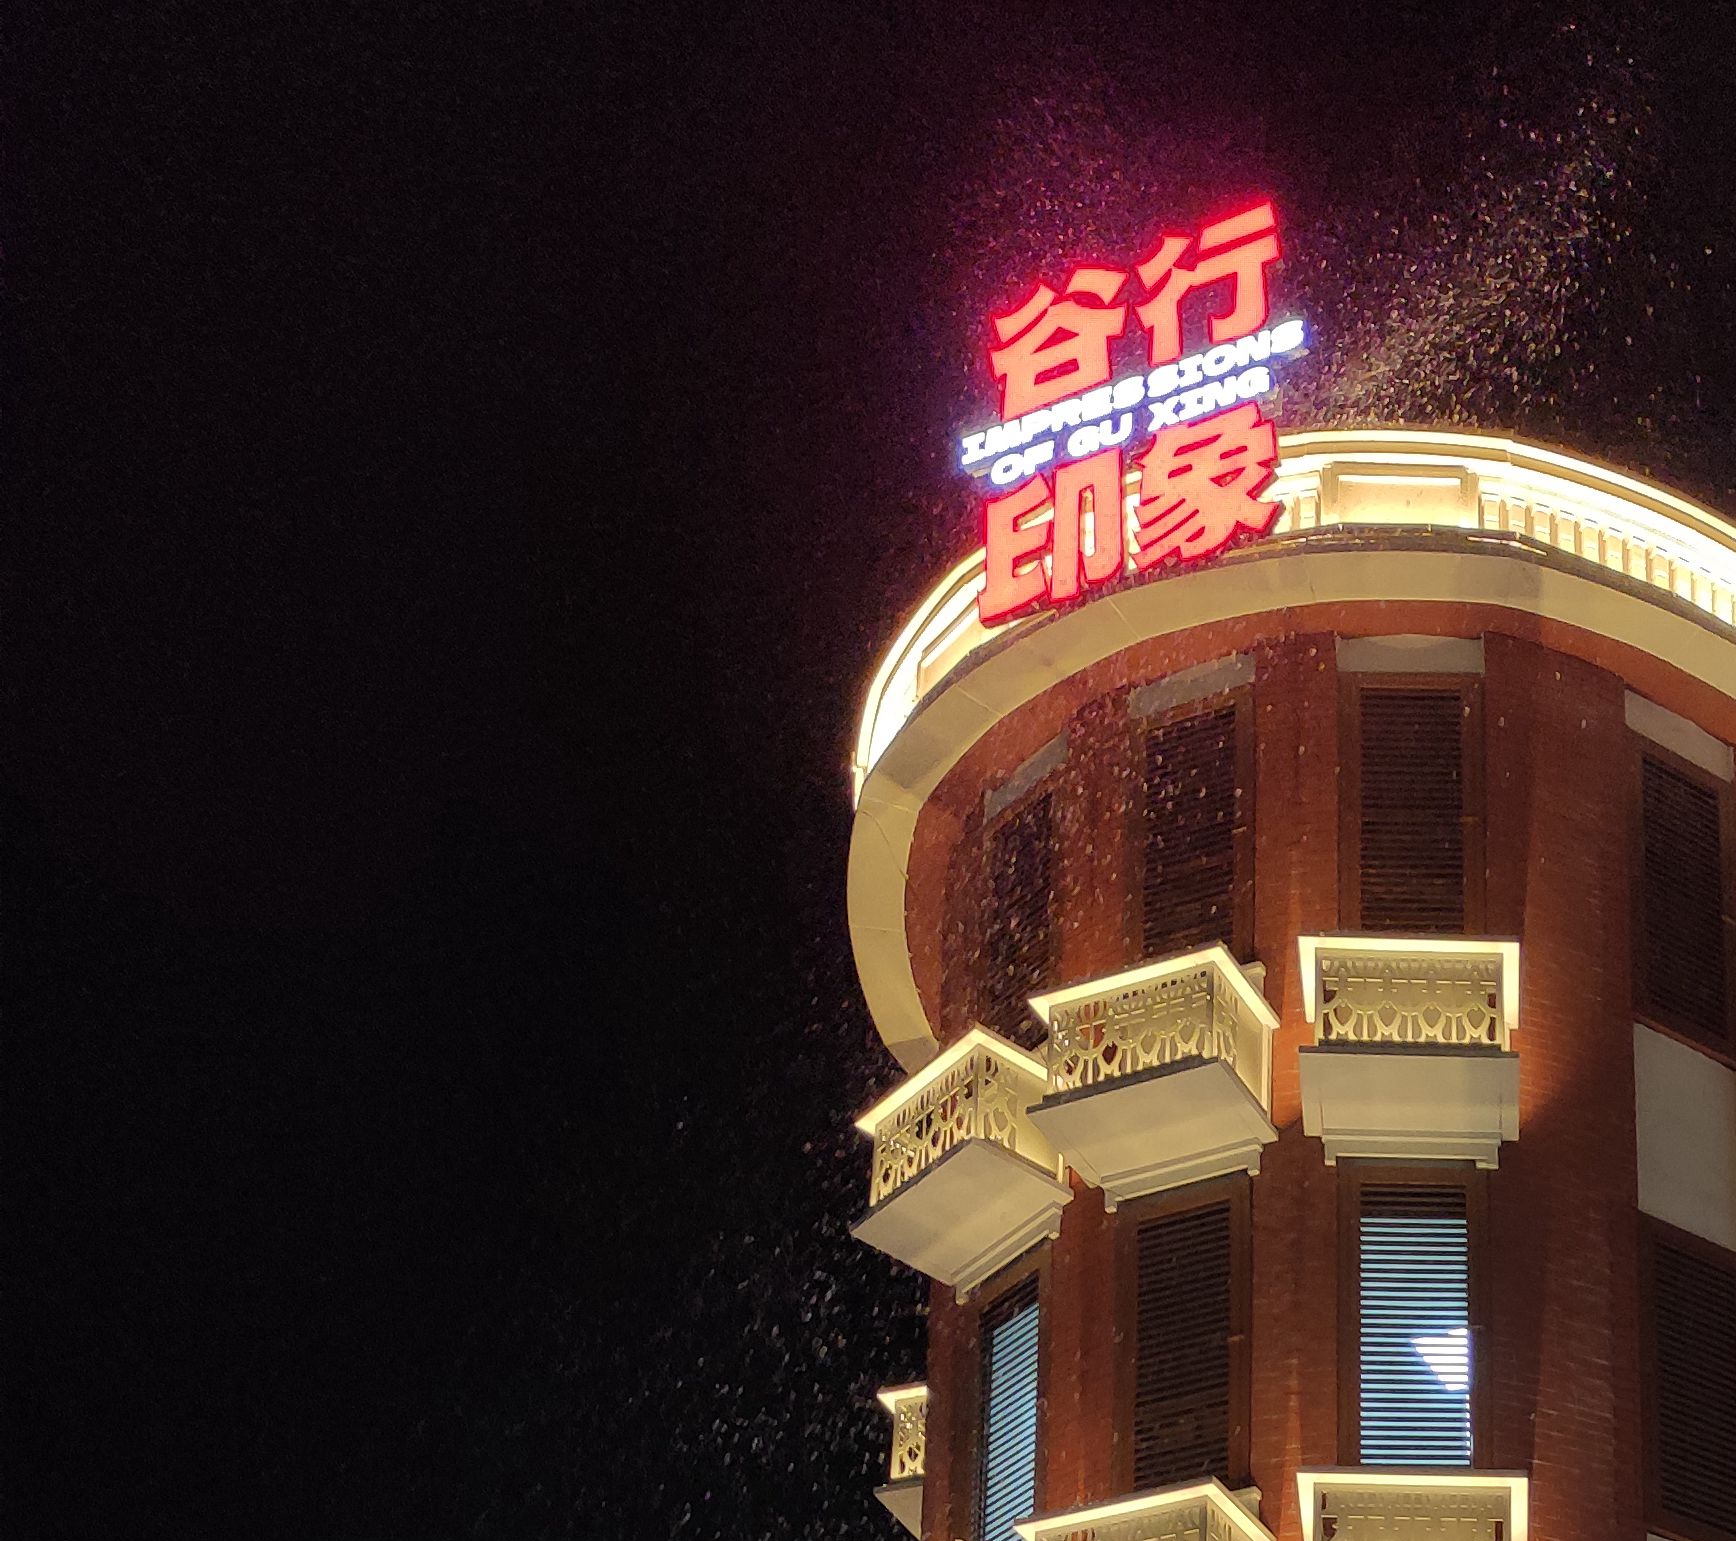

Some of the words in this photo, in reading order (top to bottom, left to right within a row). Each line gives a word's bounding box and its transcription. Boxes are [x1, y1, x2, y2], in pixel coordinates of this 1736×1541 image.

[960, 318, 1306, 468] IMPRESSIONS
[989, 199, 1281, 421] 谷行
[976, 401, 1282, 628] 印象
[989, 442, 1054, 486] OF
[1066, 411, 1133, 458] GU
[1147, 364, 1271, 433] XING
